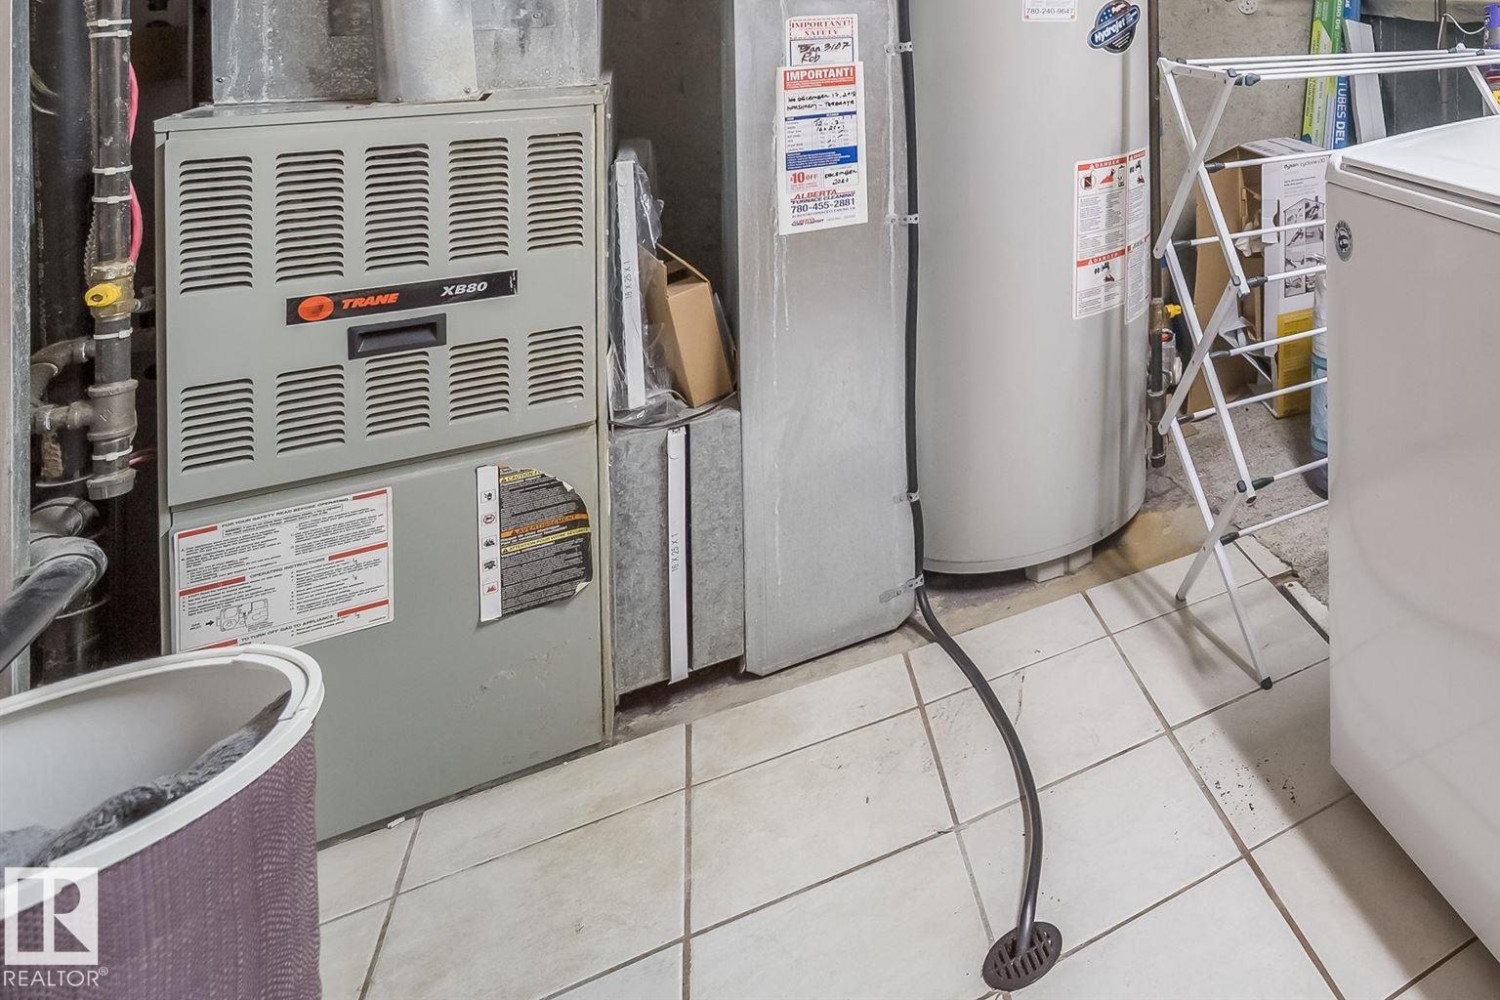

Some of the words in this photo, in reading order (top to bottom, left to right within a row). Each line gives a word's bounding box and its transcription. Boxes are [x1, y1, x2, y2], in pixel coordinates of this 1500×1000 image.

[787, 67, 853, 81] IMPORTANT!
[1336, 80, 1348, 119] TUBES
[1095, 159, 1120, 169] DANGER
[794, 189, 837, 200] ALBERTA
[341, 292, 400, 310] TRANE
[440, 281, 488, 297] XB80
